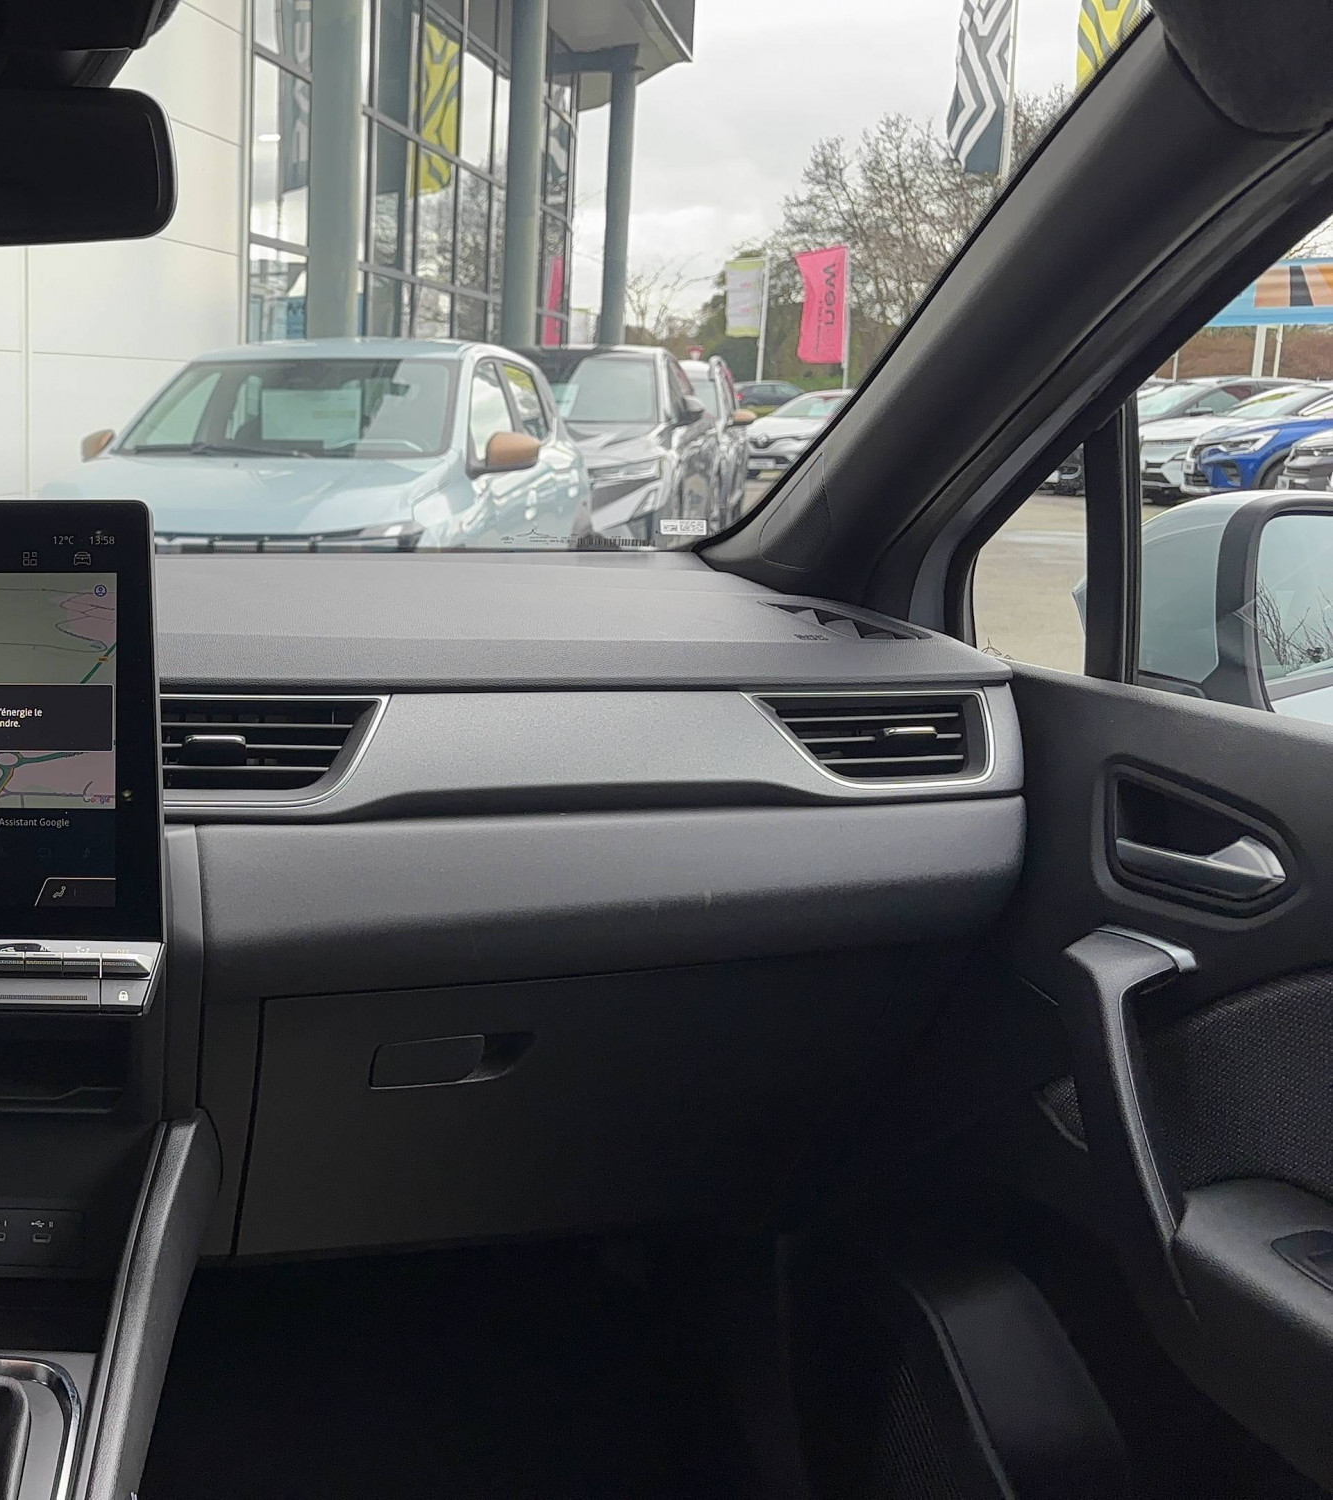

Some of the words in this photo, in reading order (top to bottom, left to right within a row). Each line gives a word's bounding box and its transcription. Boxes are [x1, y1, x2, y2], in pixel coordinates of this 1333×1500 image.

[52, 535, 75, 545] 12°C
[89, 535, 115, 545] 13:58
[34, 708, 42, 716] le
[39, 818, 70, 828] Google
